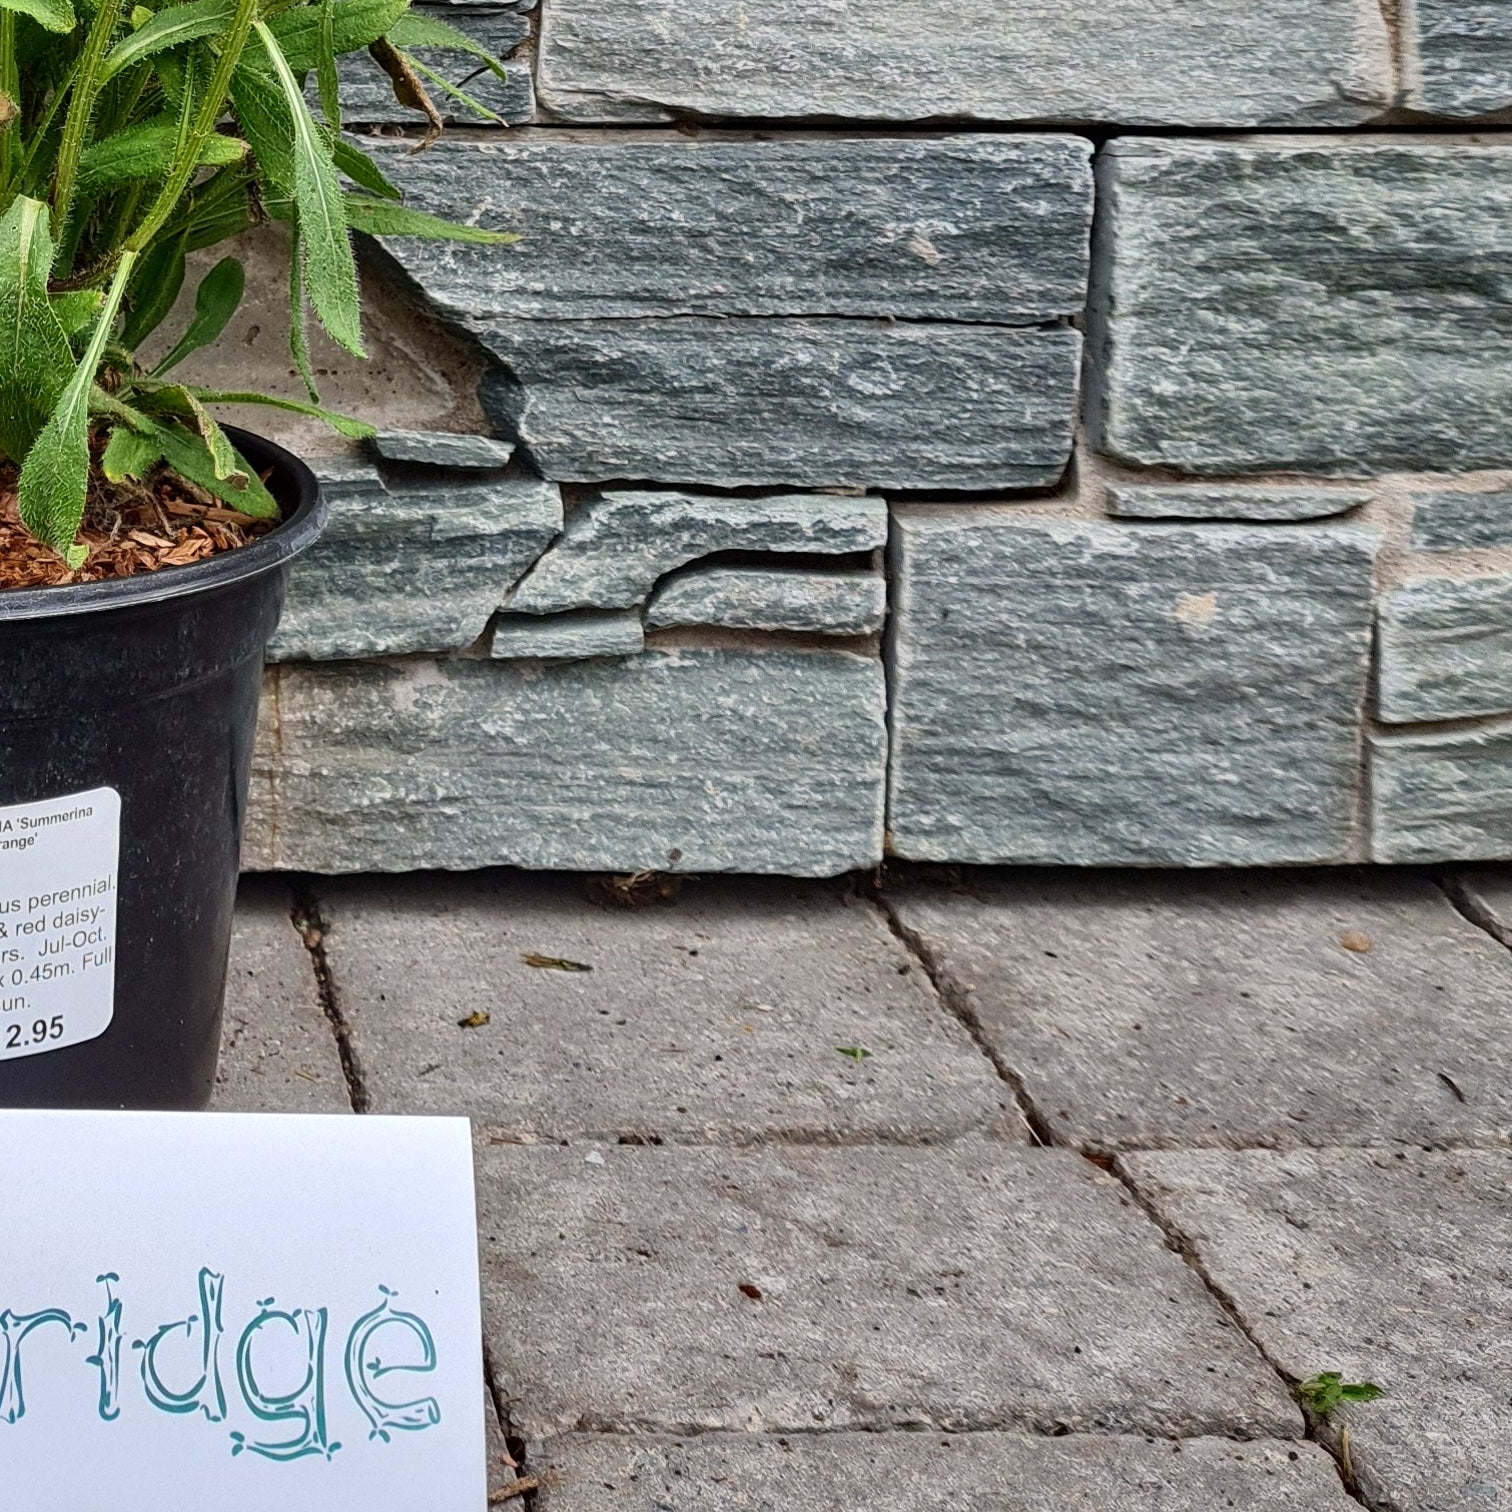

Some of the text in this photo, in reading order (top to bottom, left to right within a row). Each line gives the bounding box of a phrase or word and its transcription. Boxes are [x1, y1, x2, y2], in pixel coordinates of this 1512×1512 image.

[16, 806, 93, 830] 'Summerina
[28, 874, 116, 914] perennial.
[15, 918, 46, 937] red
[52, 905, 106, 929] daisy-
[38, 926, 107, 957] Jul-Oct.
[11, 963, 75, 986] 0.45m.
[82, 946, 112, 970] Full
